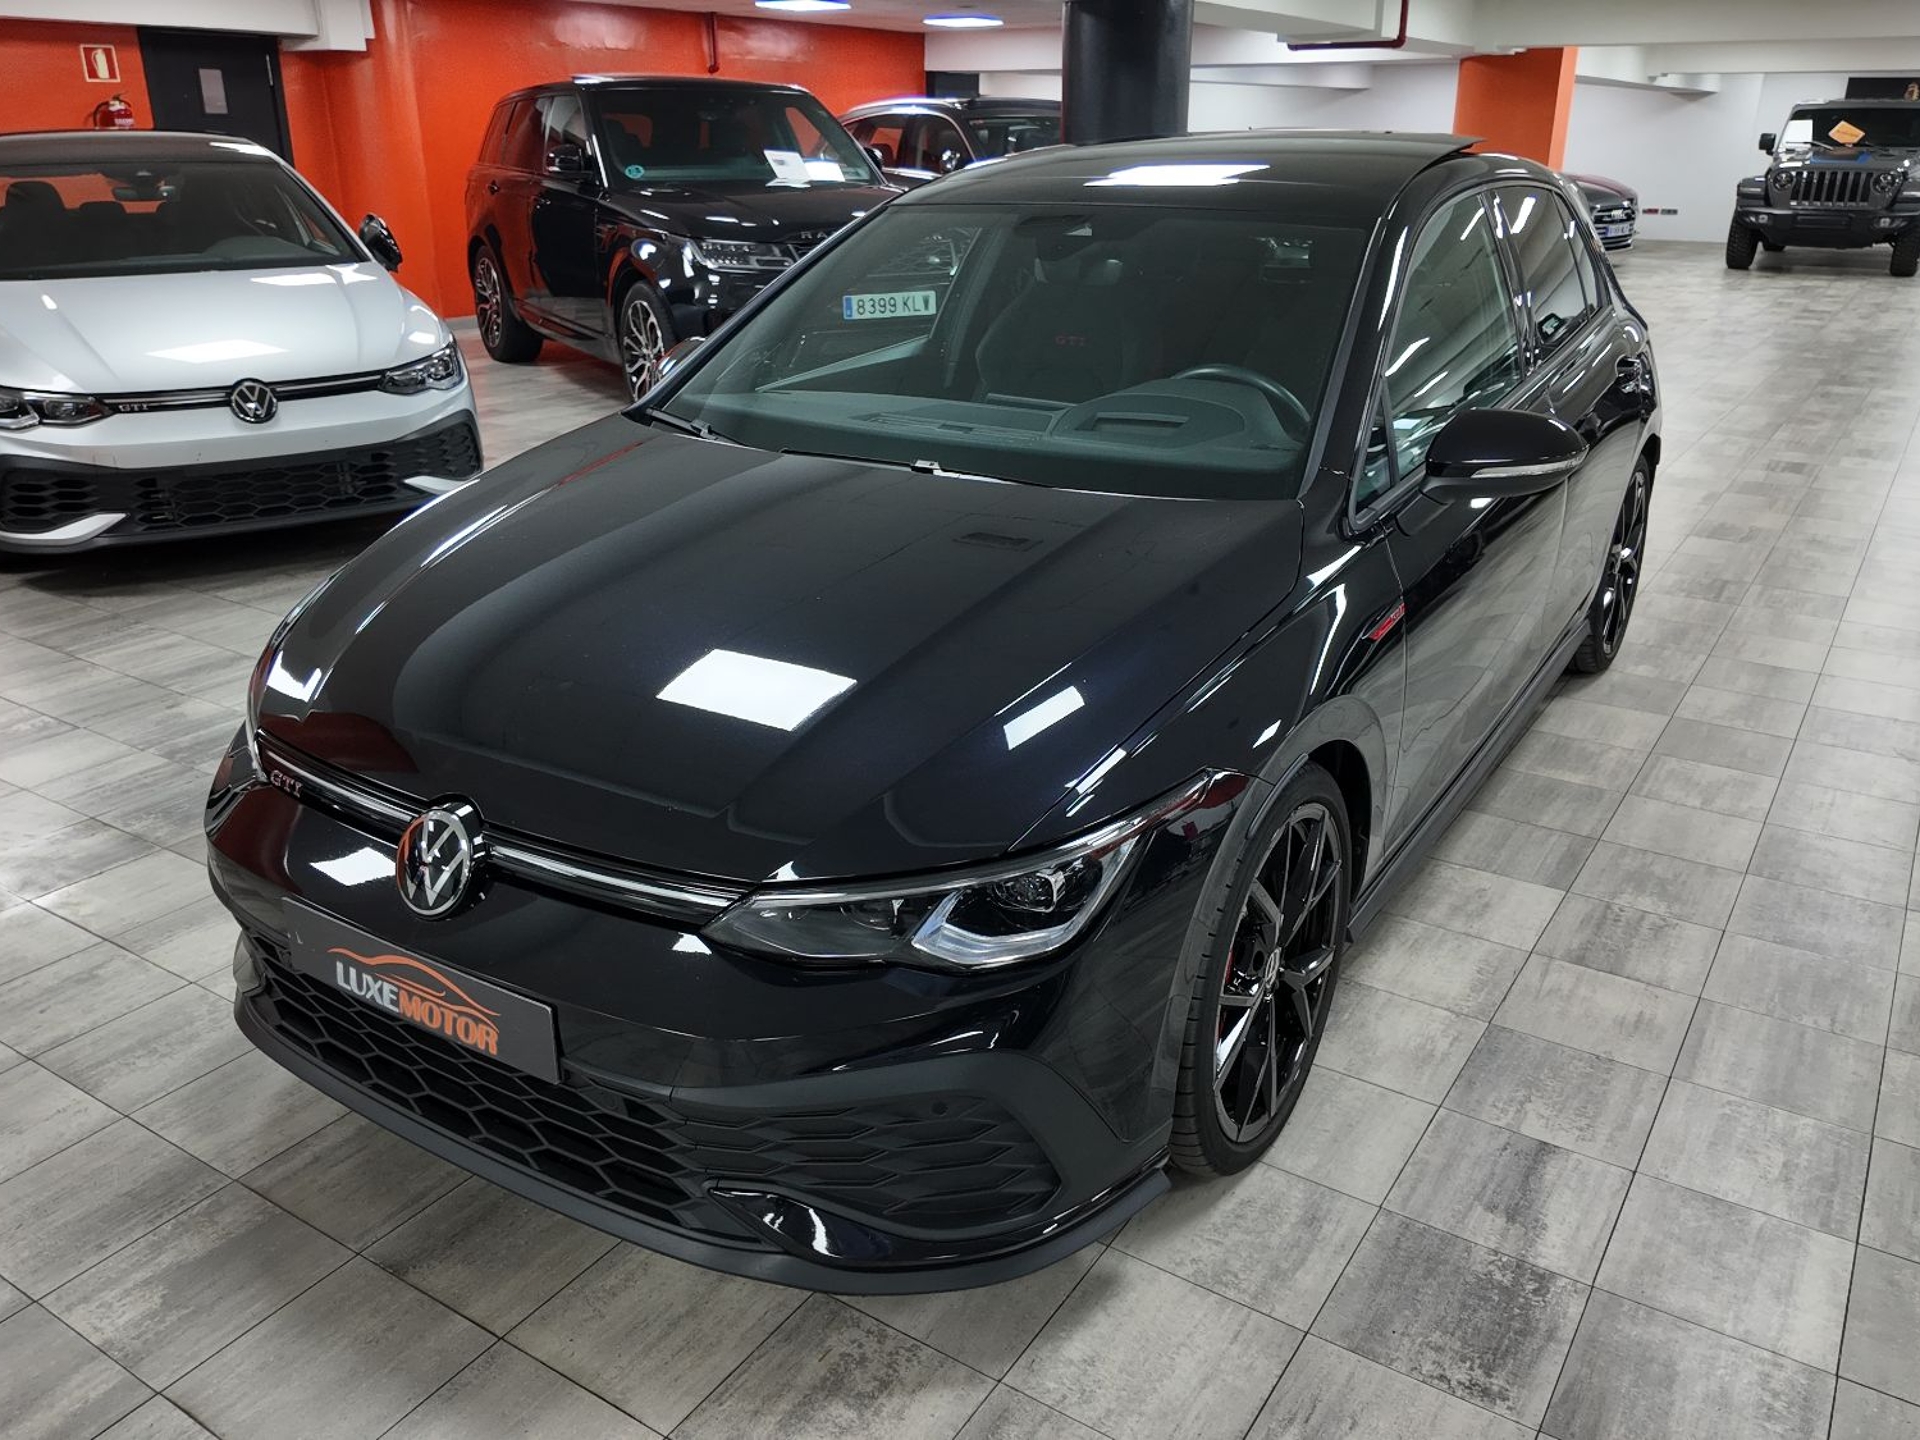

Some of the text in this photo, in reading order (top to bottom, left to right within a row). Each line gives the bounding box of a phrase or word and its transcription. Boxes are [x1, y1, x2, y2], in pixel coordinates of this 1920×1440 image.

[857, 296, 897, 316] 8399
[118, 402, 149, 412] GTI
[269, 769, 303, 798] GTI
[335, 960, 499, 1056] LUXEMOTOR
